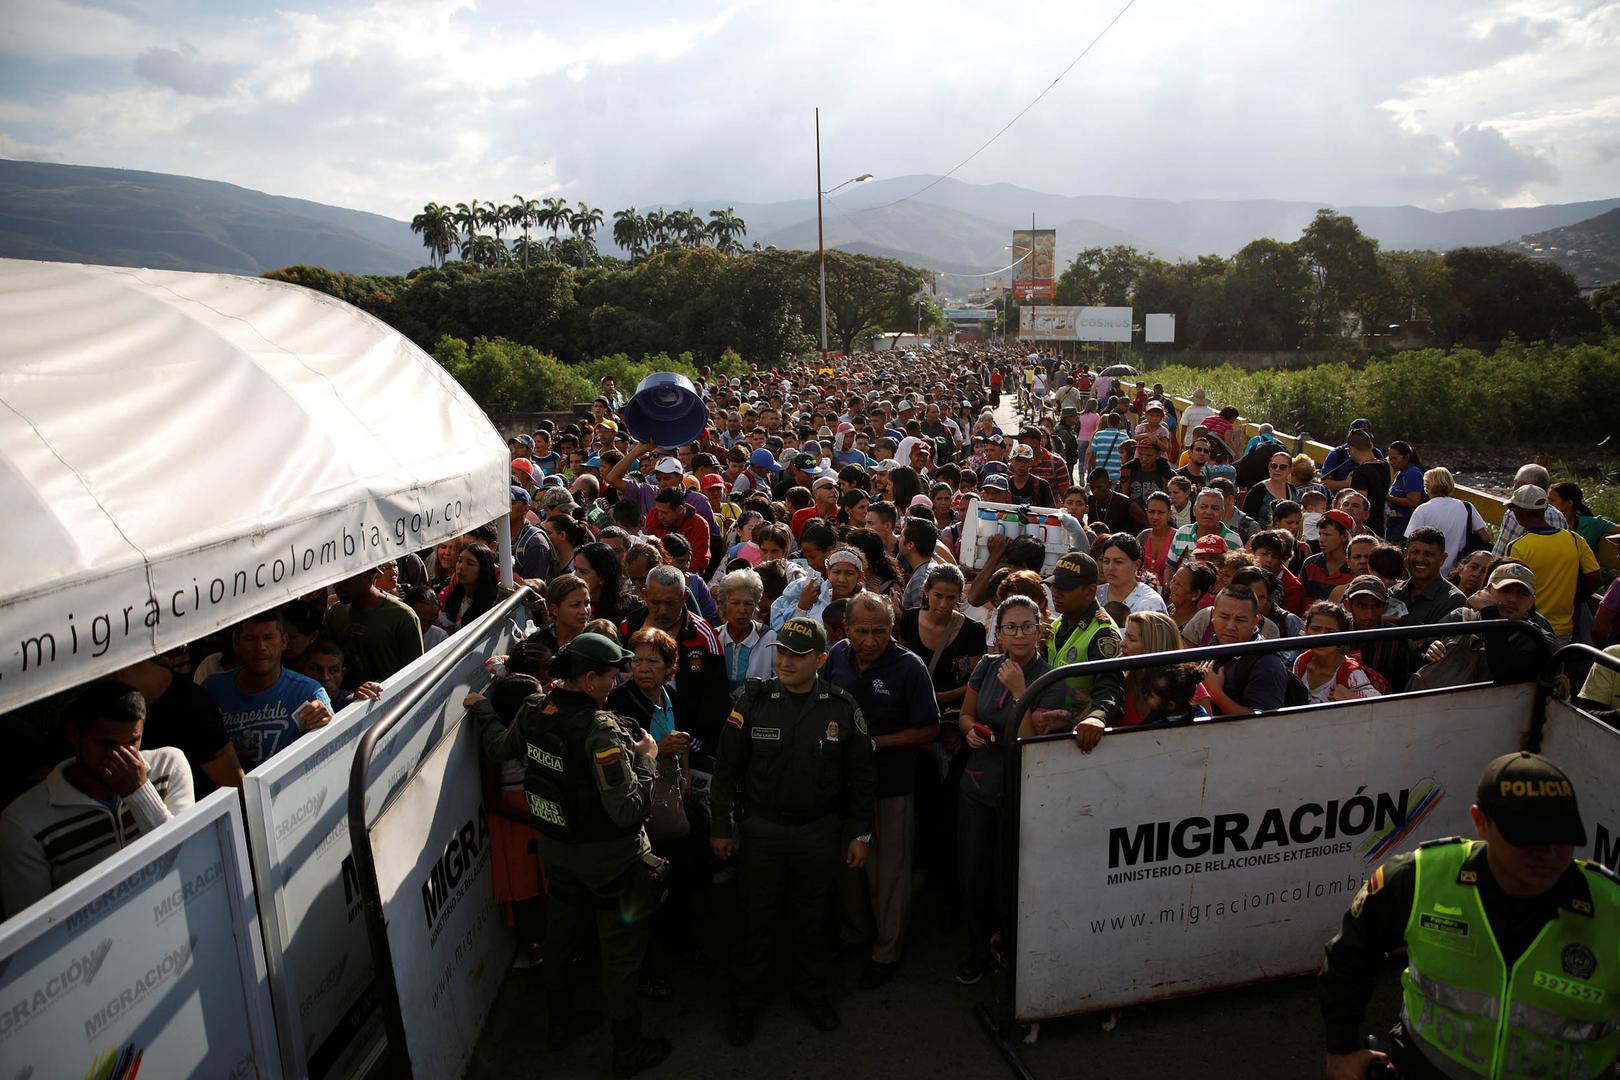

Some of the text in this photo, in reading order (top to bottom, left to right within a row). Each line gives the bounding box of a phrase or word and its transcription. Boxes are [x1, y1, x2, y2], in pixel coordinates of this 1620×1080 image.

[528, 745, 562, 769] POLICIA
[1500, 779, 1570, 798] POLICIA
[1107, 786, 1410, 869] MIGRACIÓN
[1107, 841, 1353, 886] MINISTERIO DE RELACIONES EXTERIORES
[84, 945, 189, 1038] MIGRACIÓN
[1537, 973, 1602, 1002] 397557
